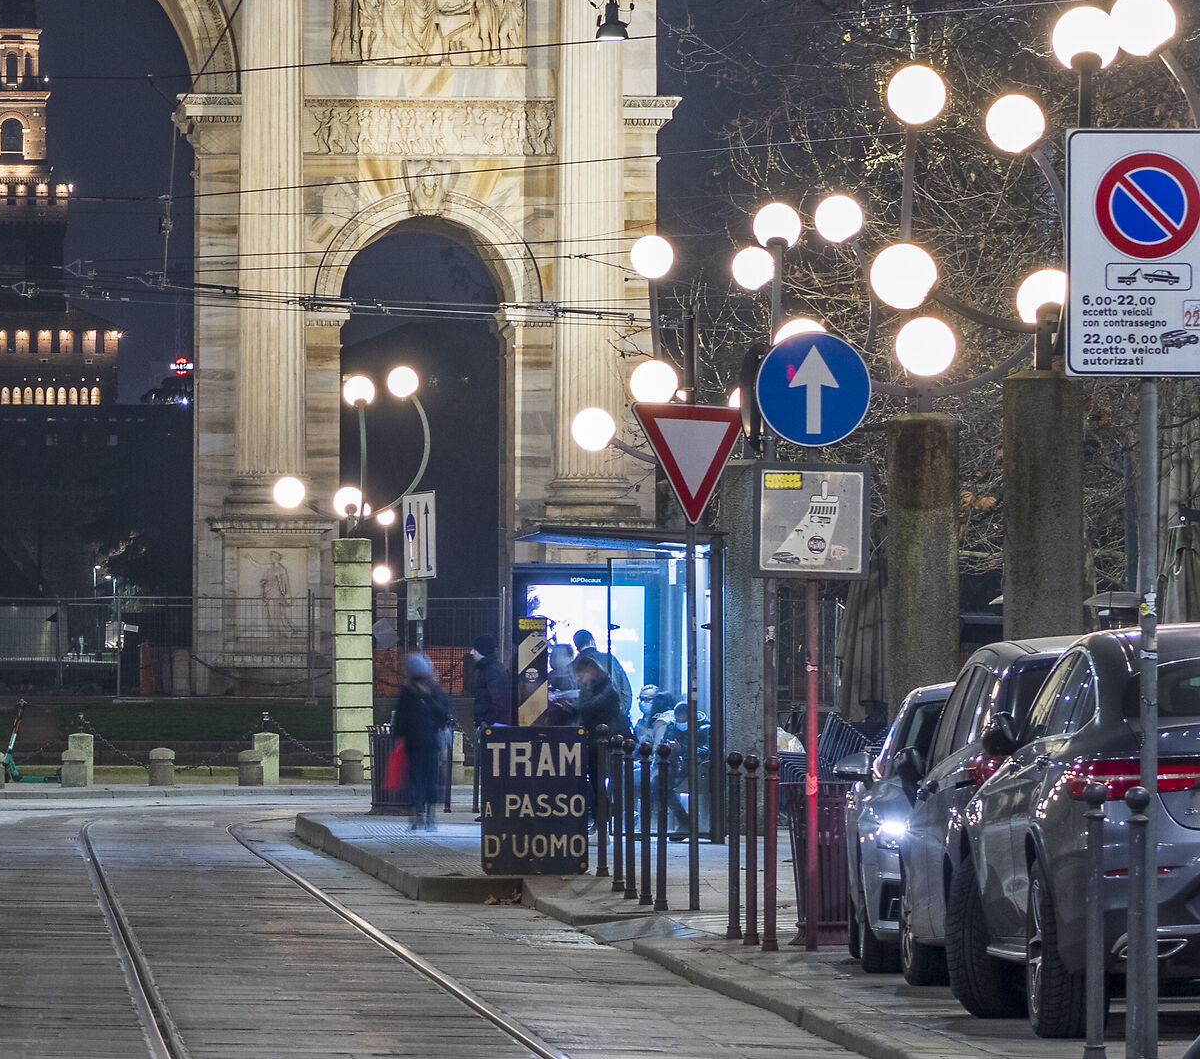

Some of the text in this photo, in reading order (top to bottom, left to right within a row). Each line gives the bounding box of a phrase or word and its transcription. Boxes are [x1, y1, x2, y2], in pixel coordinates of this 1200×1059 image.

[1082, 307, 1153, 317] eccetto veicoli
[1082, 319, 1167, 329] con contrassegno
[1082, 345, 1169, 355] eccetto veicoli
[1082, 356, 1144, 366] autorizzati
[486, 742, 583, 777] TRAM
[485, 793, 586, 818] A PASSO
